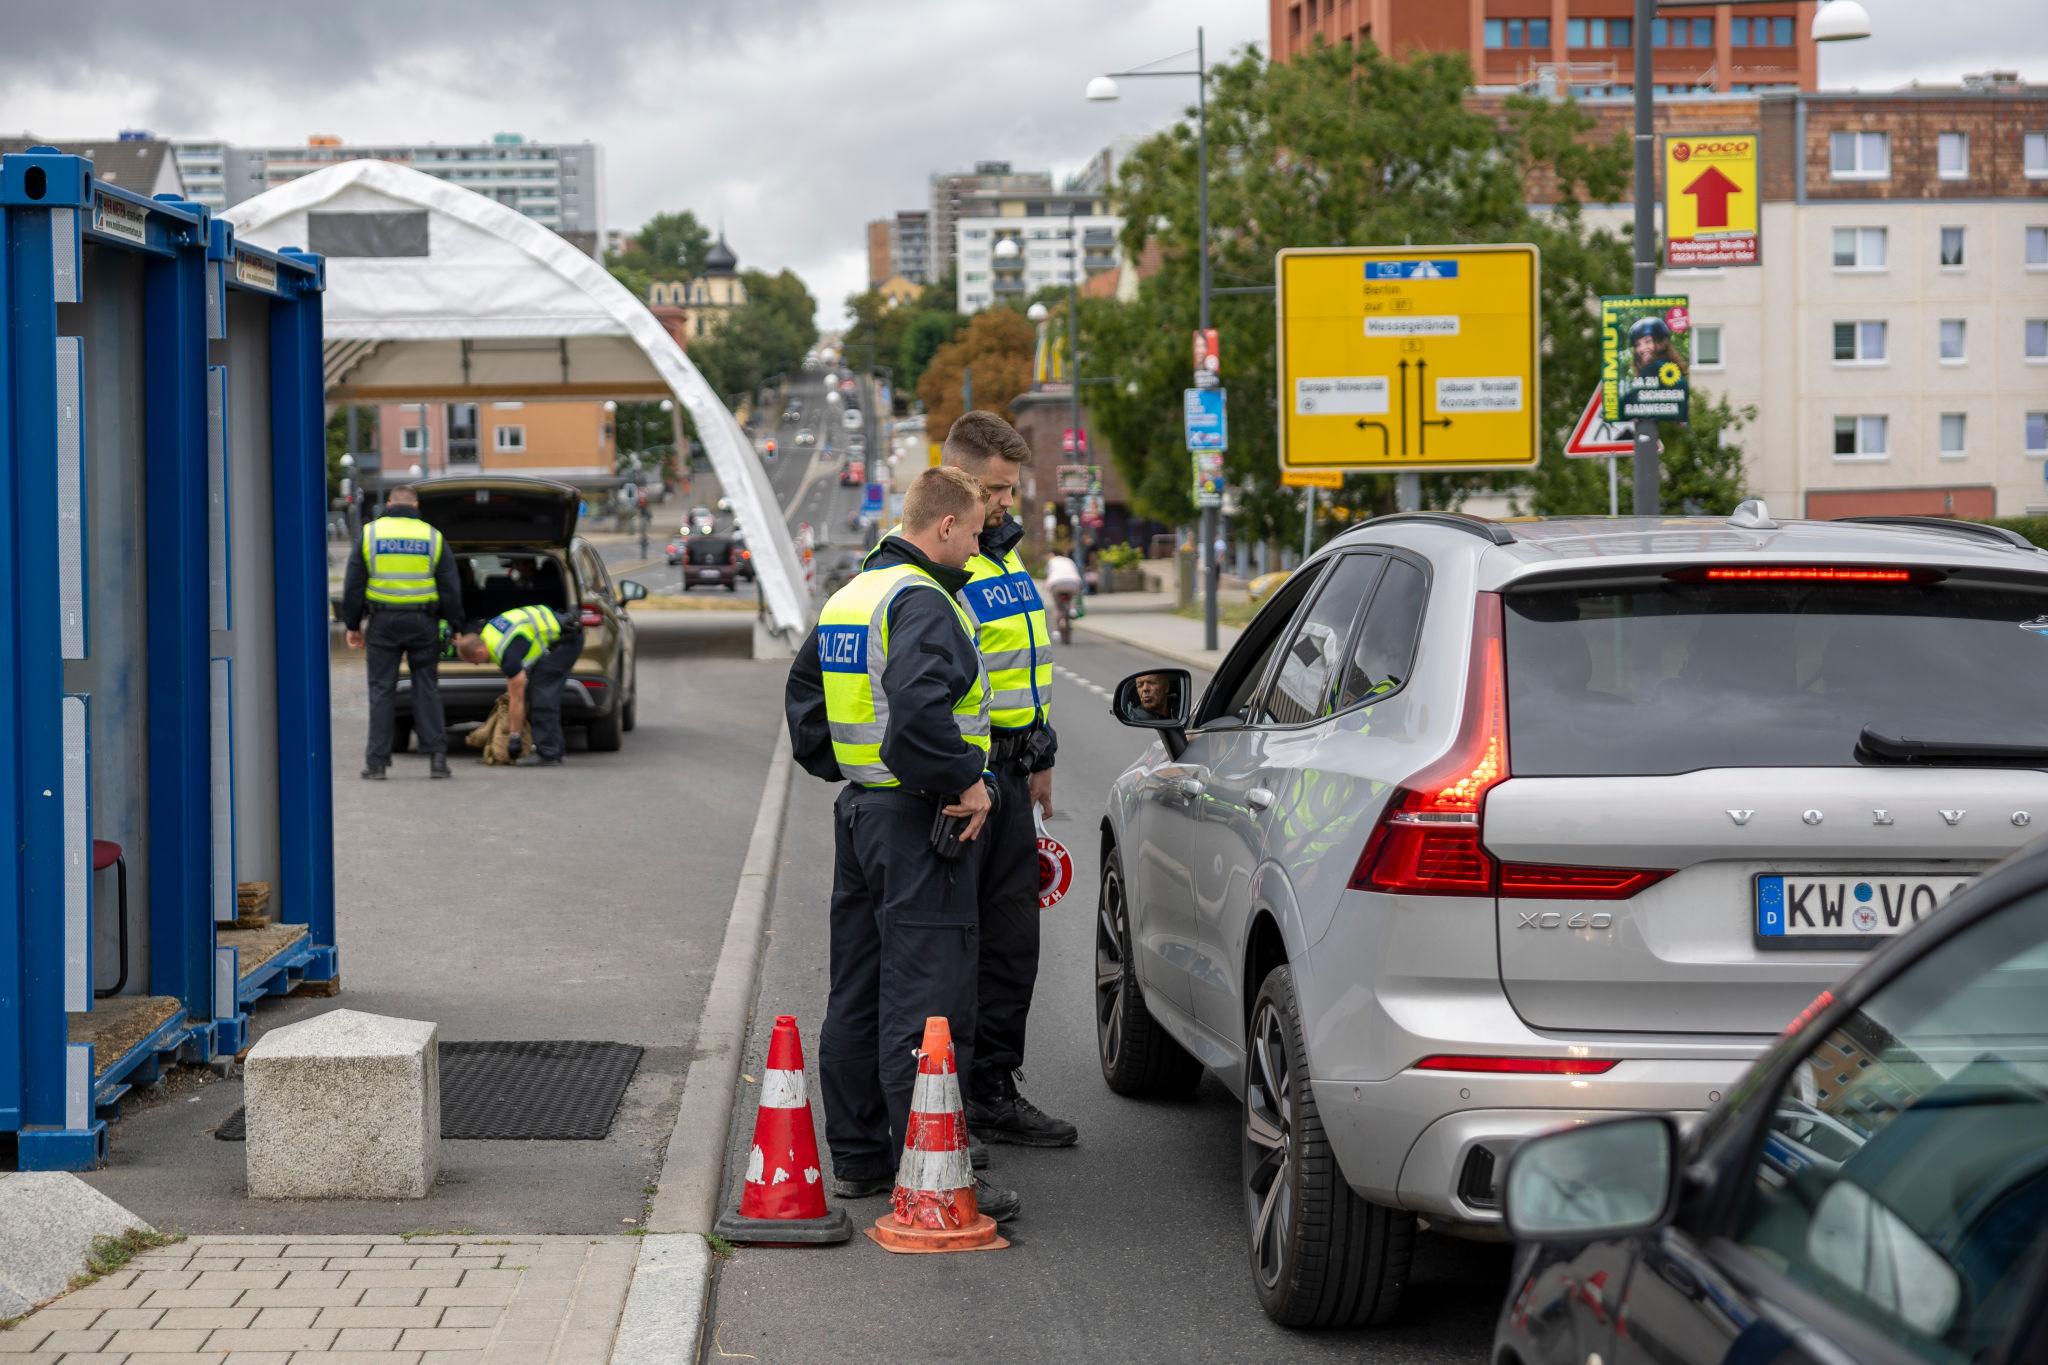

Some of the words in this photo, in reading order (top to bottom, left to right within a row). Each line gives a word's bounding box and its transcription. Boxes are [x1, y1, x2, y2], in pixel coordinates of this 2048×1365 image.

[1695, 142, 1749, 154] POCO
[1363, 284, 1400, 295] Berlin
[1603, 298, 1686, 308] EINANDER
[1631, 377, 1644, 387] JA
[1645, 376, 1659, 387] ZU
[1605, 381, 1618, 419] MEHR
[1638, 389, 1685, 400] SICHEREN
[1624, 403, 1679, 415] RADWEGEN
[379, 540, 428, 552] POLIZEI
[818, 632, 860, 664] OLIZEI
[1726, 809, 2032, 826] VOLVO
[1788, 883, 1845, 927] KW
[1766, 911, 1777, 925] D
